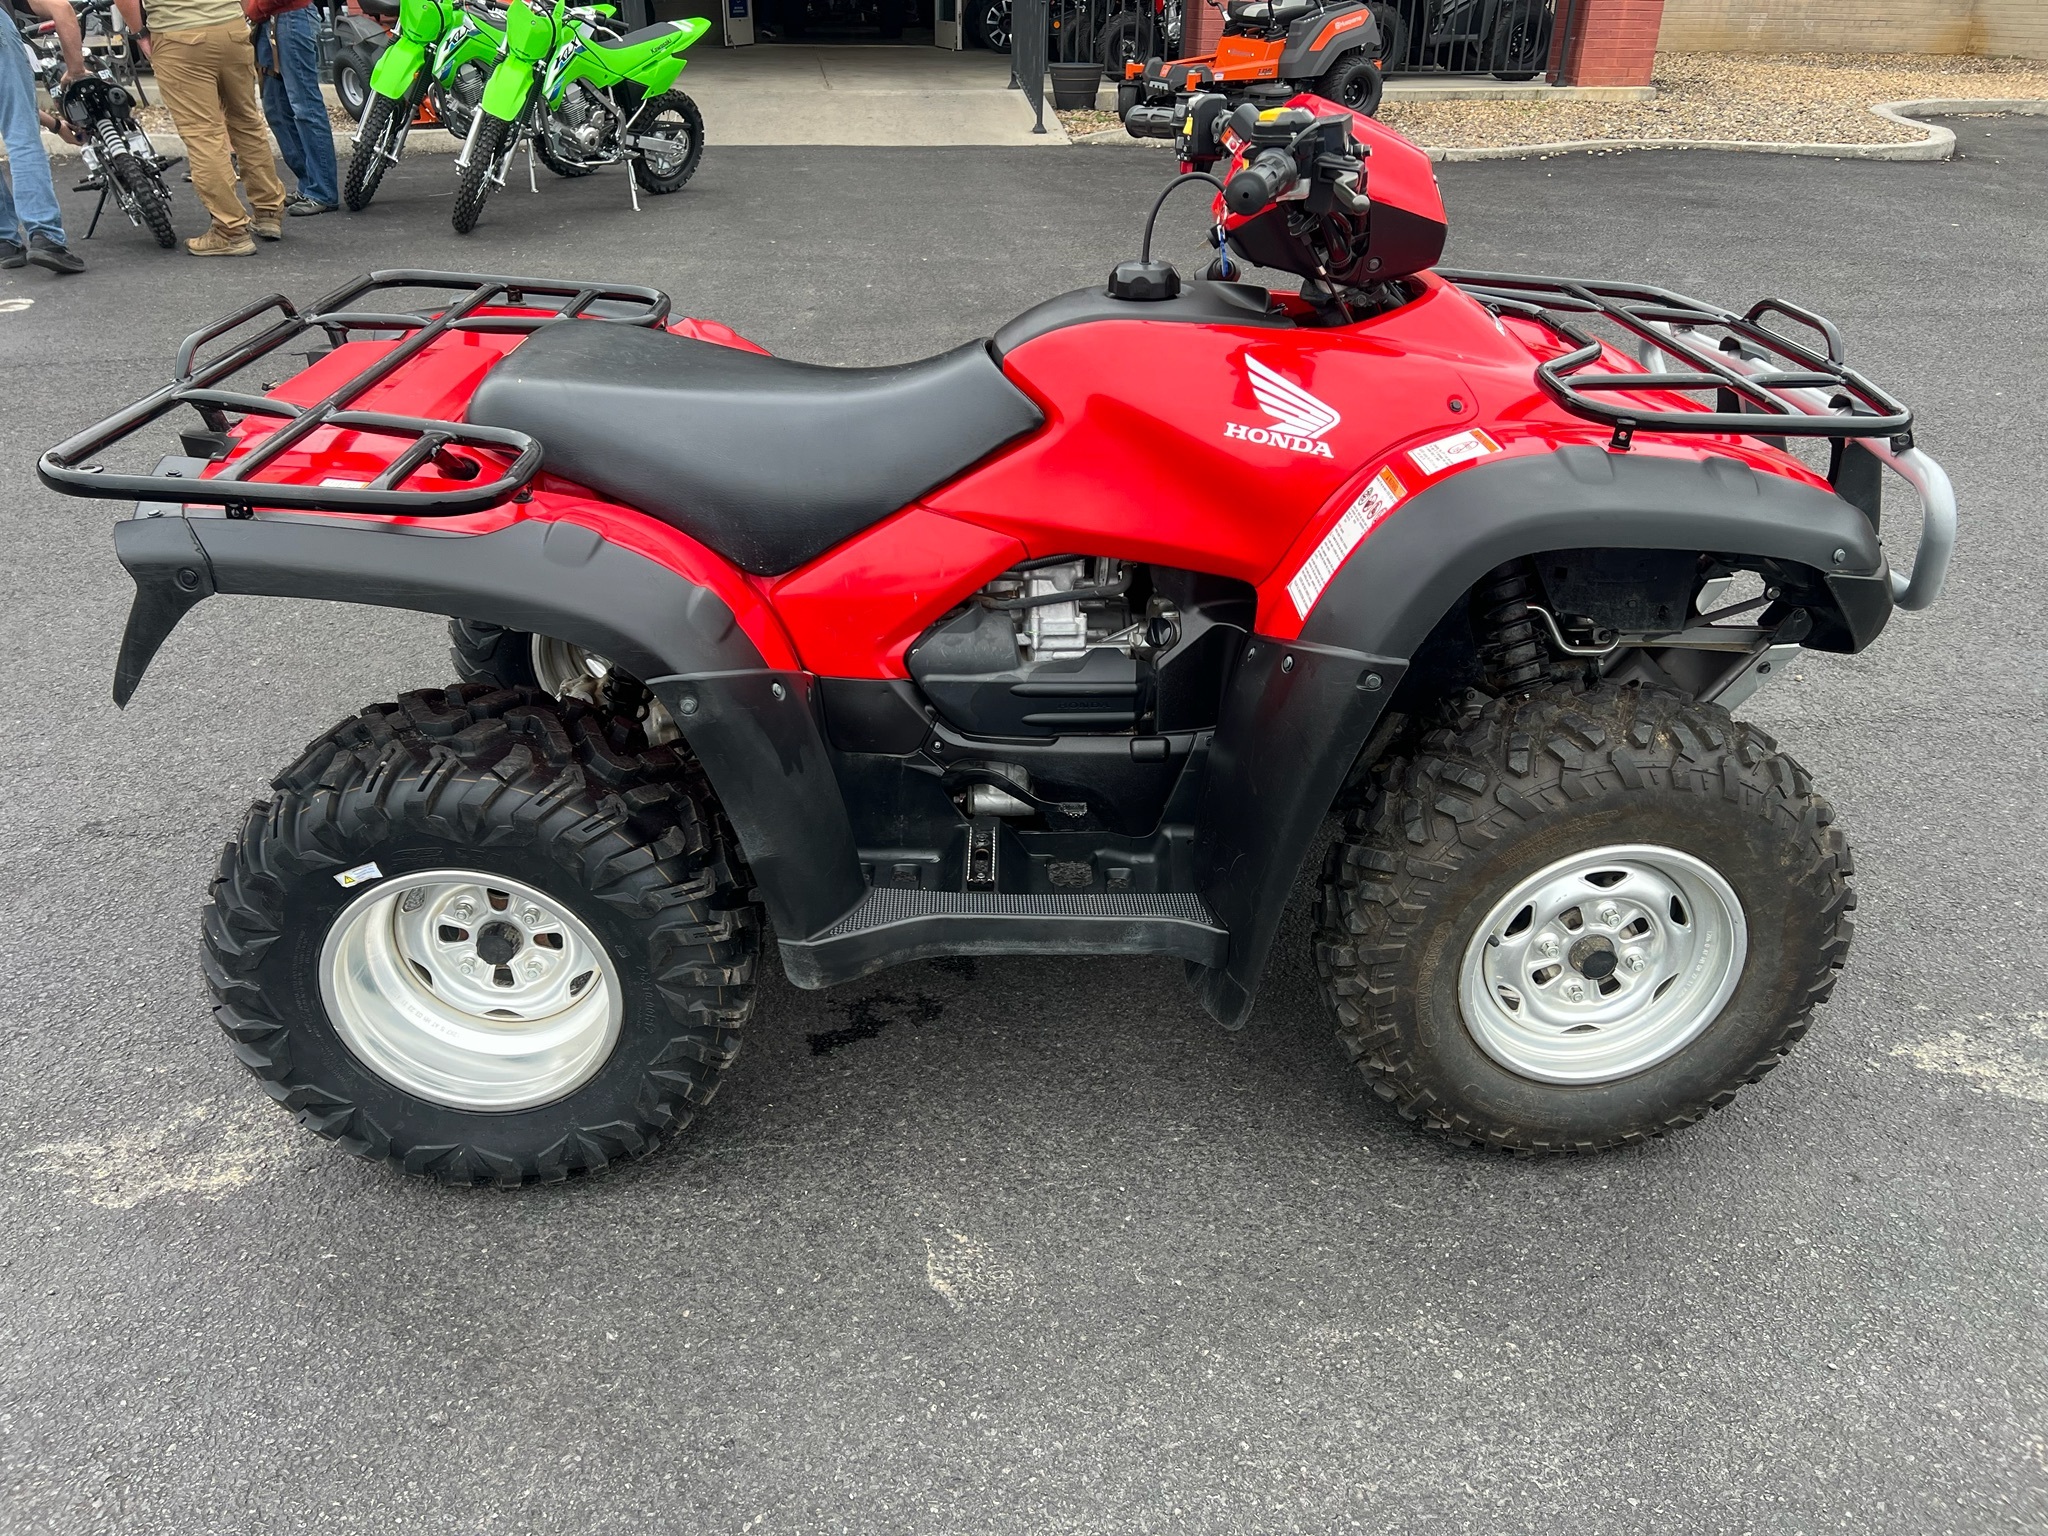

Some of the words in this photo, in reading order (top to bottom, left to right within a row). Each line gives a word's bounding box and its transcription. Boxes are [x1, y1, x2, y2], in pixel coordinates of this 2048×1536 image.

[650, 38, 673, 54] Kawasaki
[1224, 422, 1335, 459] HONDA
[1057, 701, 1112, 710] HONDA
